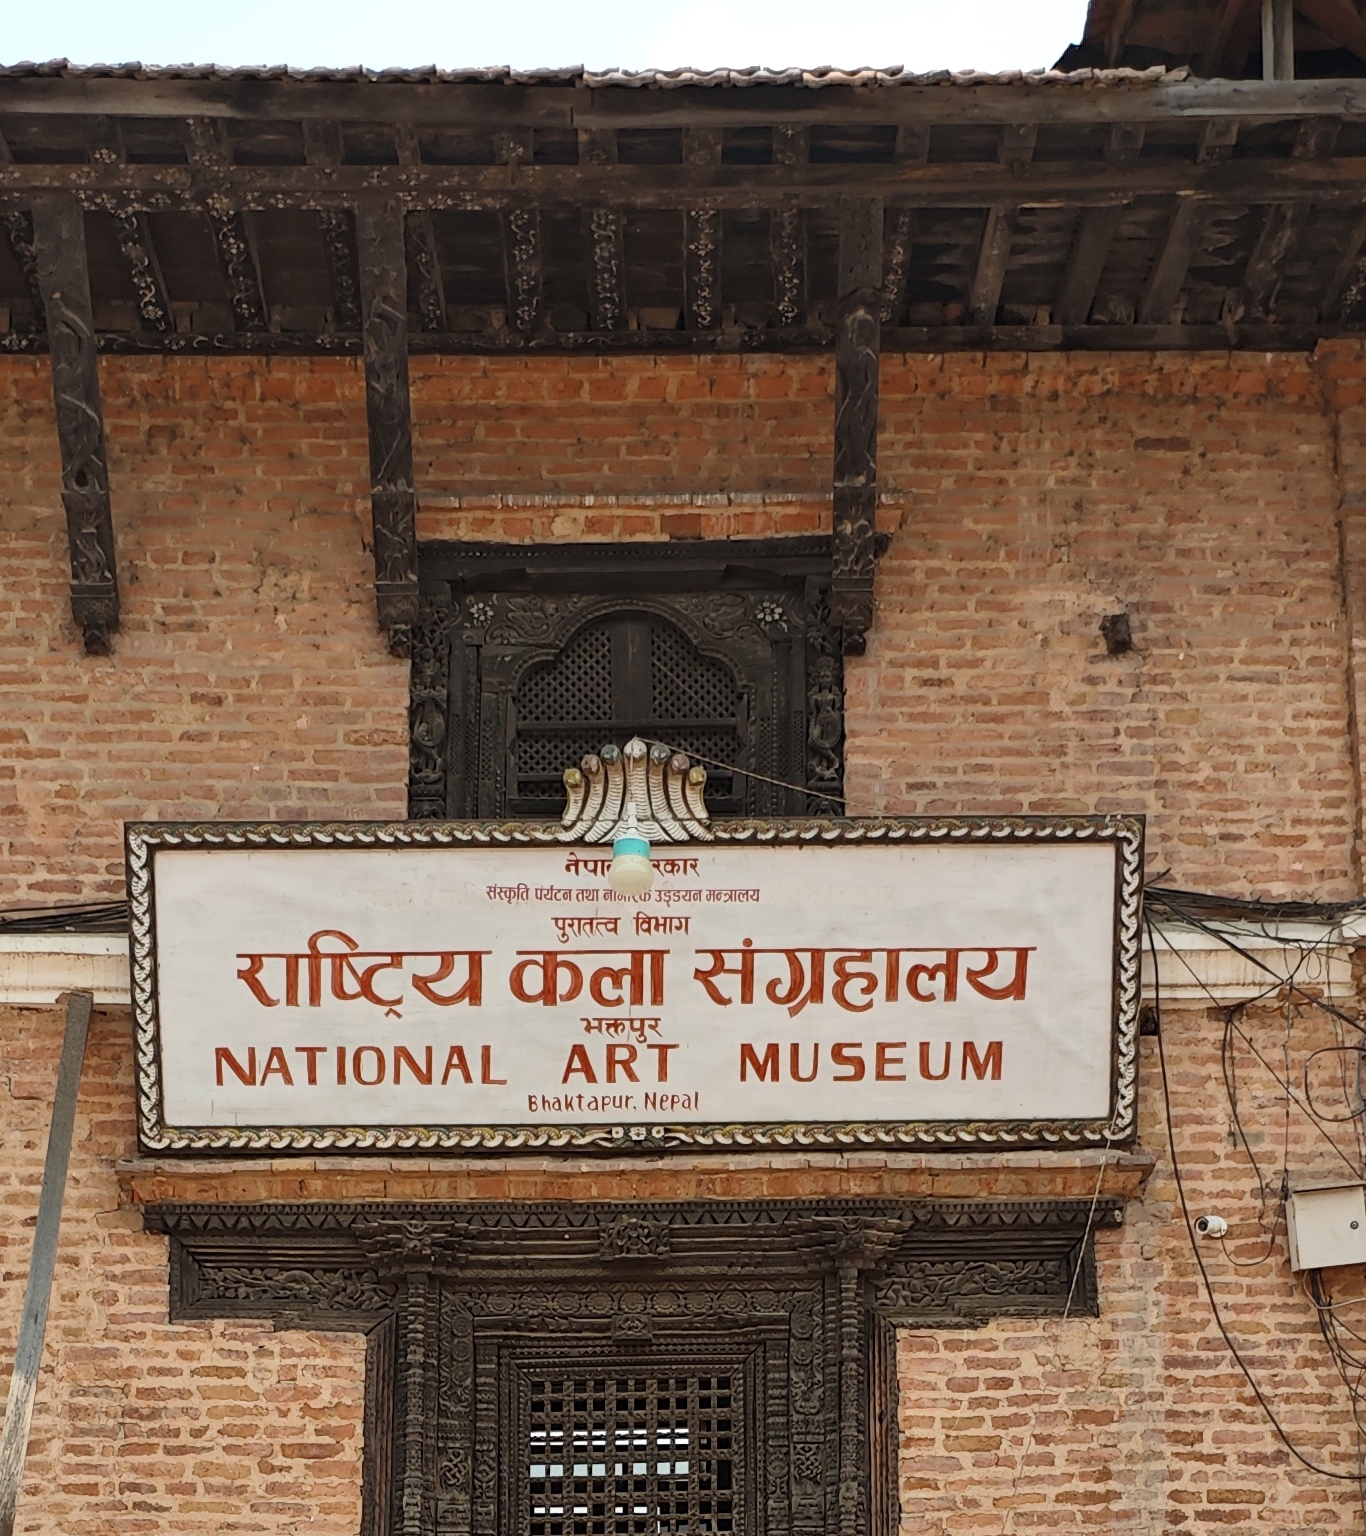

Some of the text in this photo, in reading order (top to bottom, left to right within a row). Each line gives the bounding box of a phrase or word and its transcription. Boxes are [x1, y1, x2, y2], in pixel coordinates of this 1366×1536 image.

[649, 858, 700, 877] रकार
[486, 883, 530, 904] संस्कृति
[576, 888, 599, 902] तथा
[706, 888, 760, 904] मन्त्रालय
[634, 911, 691, 936] विभाग
[509, 949, 670, 1006] कला
[693, 937, 1037, 1018] संग्रहालय
[580, 1017, 663, 1044] भक्तपुर
[215, 1041, 1003, 1087] NATIONAL ART MUSEUM
[528, 1091, 699, 1112] Bhaktapur, Nepal
